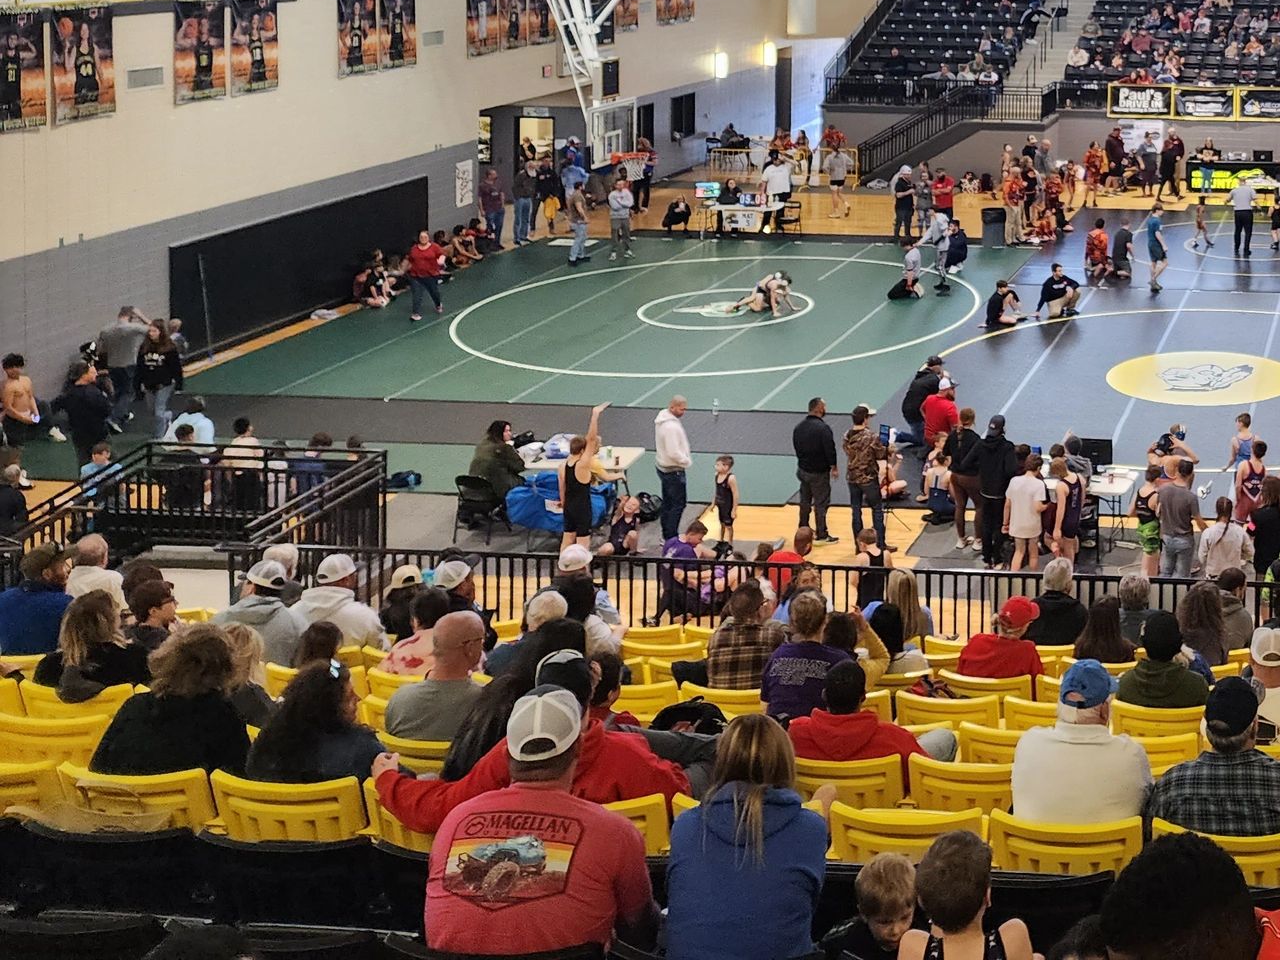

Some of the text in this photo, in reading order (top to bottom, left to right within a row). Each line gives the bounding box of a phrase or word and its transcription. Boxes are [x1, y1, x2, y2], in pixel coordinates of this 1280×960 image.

[1119, 87, 1163, 101] Paul's
[1119, 100, 1163, 108] DRIVE IN
[486, 814, 571, 834] MAGELLAN
